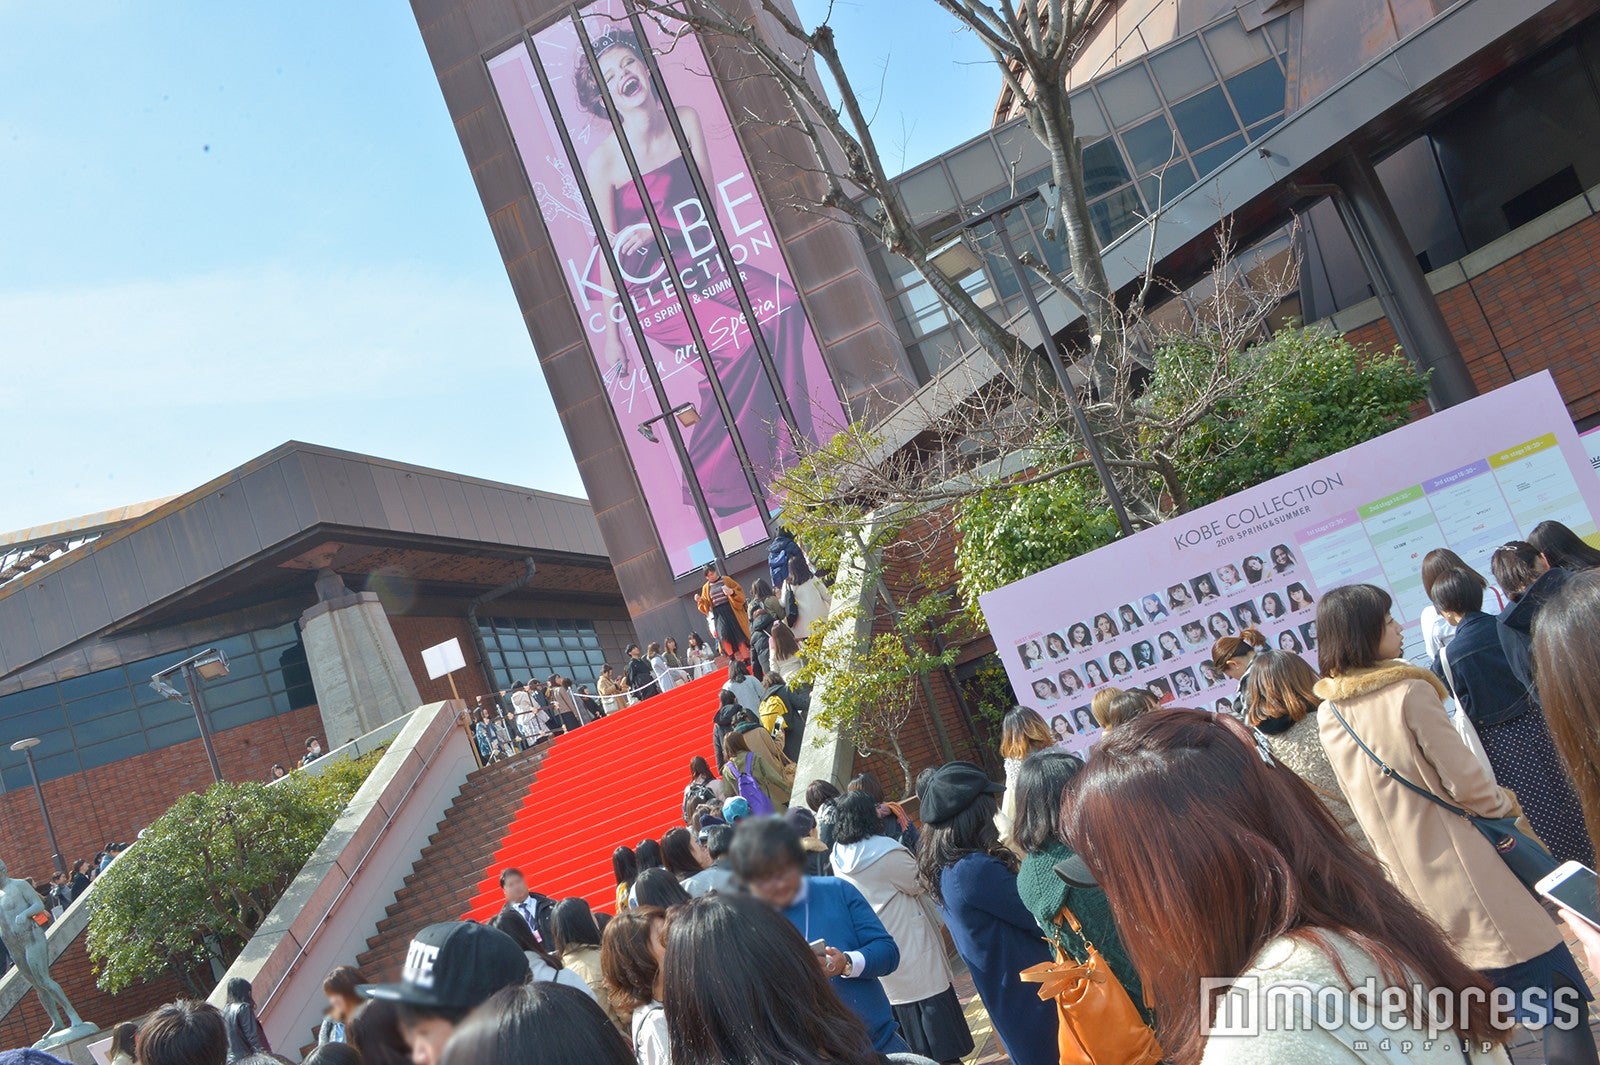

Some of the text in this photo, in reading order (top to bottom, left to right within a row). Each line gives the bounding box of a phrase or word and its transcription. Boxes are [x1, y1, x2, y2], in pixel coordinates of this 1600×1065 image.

[567, 171, 764, 311] KOBE
[588, 231, 773, 333] COLLECTION
[625, 316, 652, 338] 218
[692, 293, 703, 305] &
[701, 271, 748, 300] SUMMR
[1174, 472, 1344, 551] KOBE COLLECTION
[1216, 505, 1311, 548] 2018 SPRING&SUMMER
